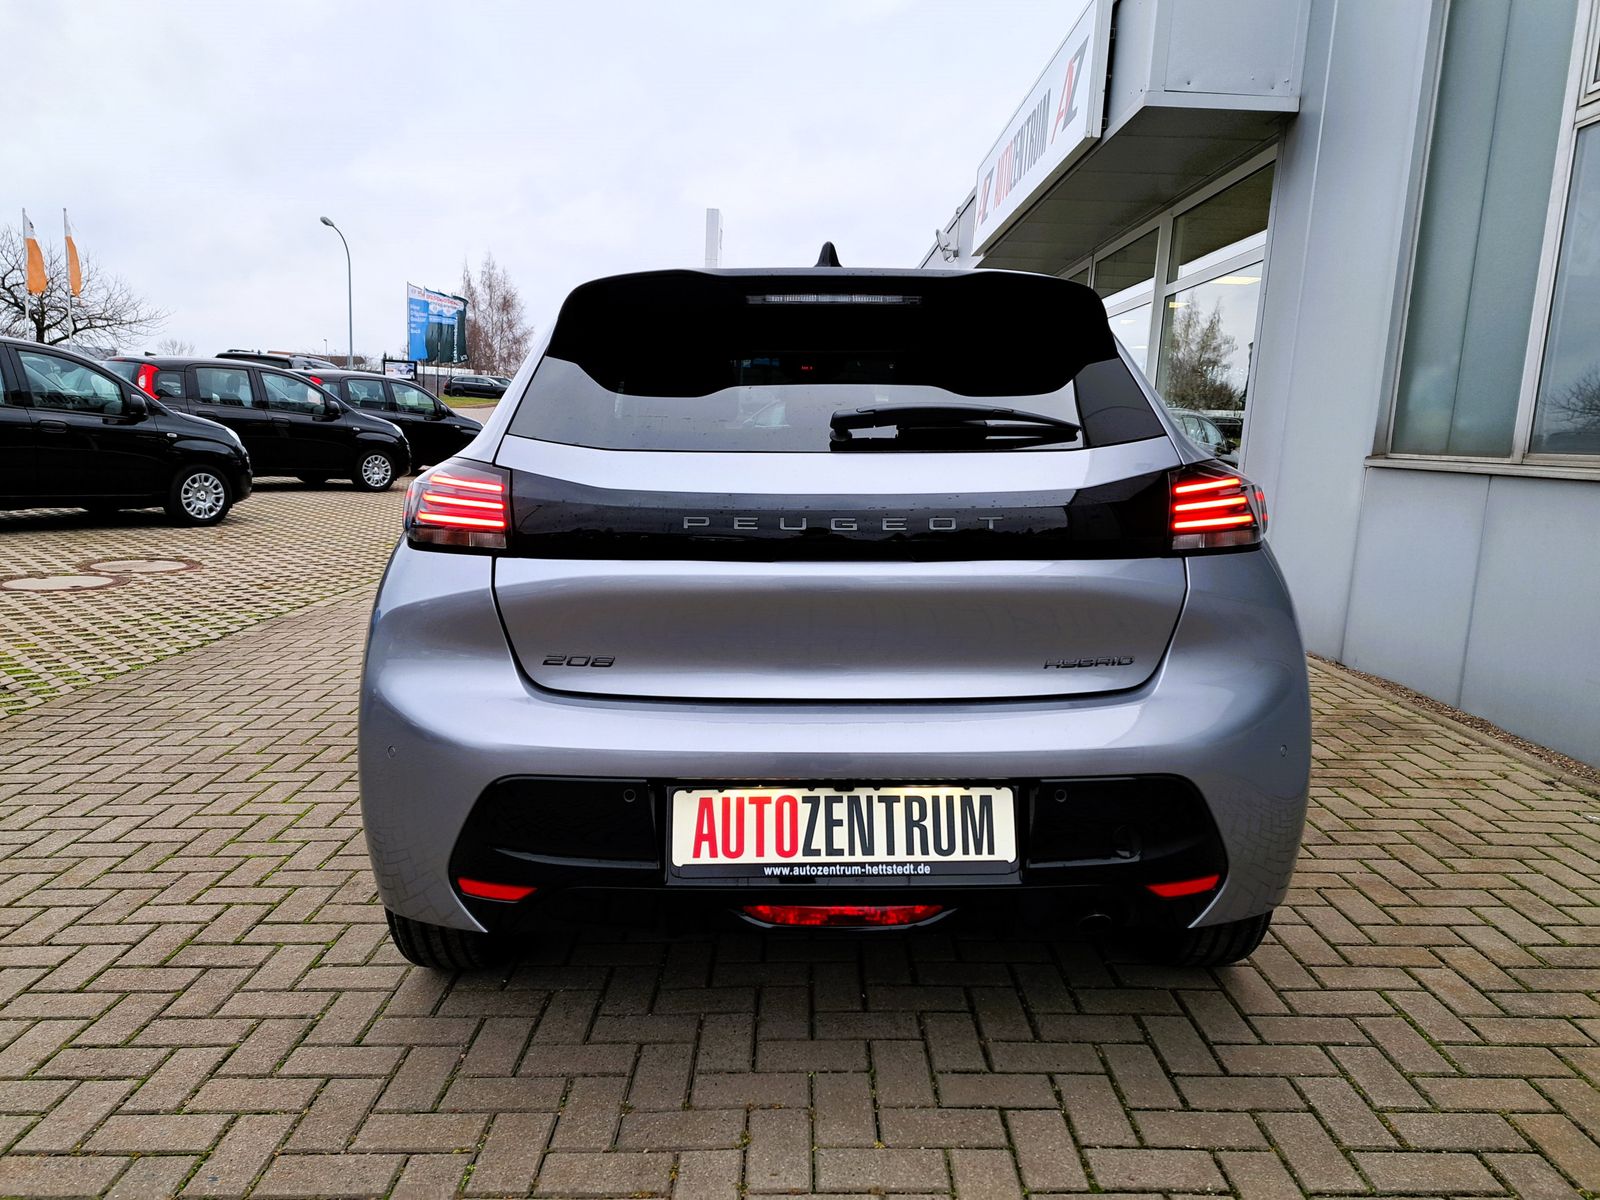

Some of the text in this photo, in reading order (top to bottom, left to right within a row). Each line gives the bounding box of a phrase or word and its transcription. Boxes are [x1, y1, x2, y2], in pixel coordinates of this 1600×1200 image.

[993, 87, 1052, 211] AUTOZENTRUM
[1051, 34, 1090, 145] AZ
[683, 516, 1004, 531] PEUGEOT
[542, 655, 615, 668] 208
[1043, 656, 1135, 669] HYBRID
[692, 795, 996, 859] AUTOZENTRUM
[763, 863, 931, 876] www.autozentrum-hettstedt.de
